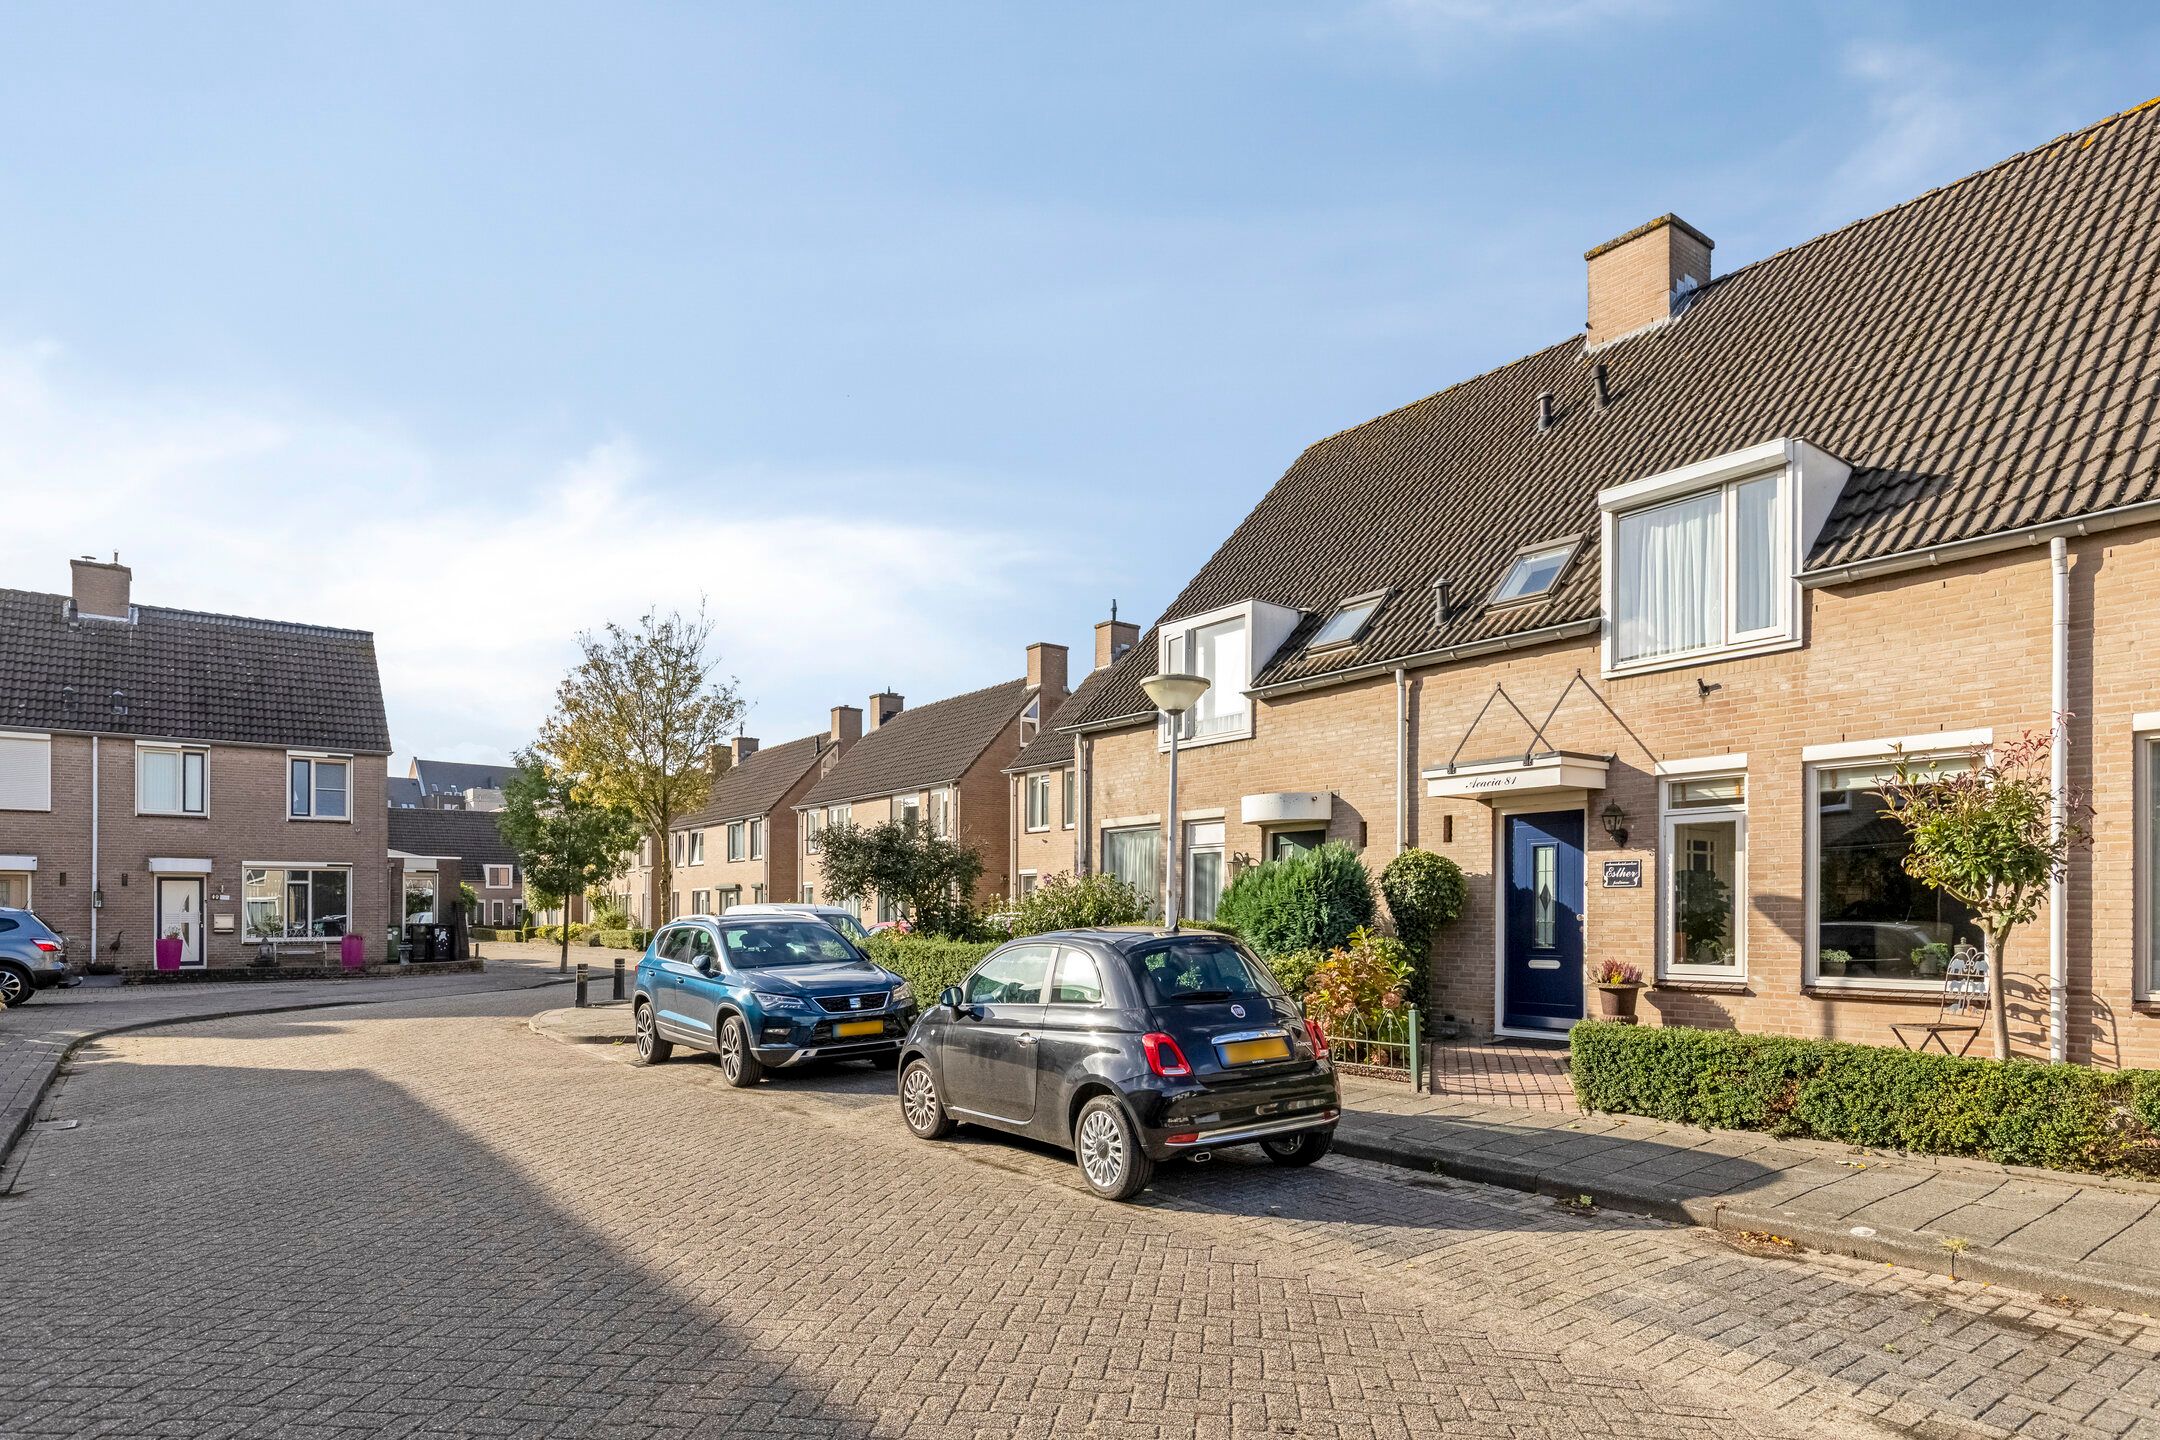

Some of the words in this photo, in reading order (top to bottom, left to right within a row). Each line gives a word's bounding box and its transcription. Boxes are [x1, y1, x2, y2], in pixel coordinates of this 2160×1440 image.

[1465, 777, 1501, 788] Acacia
[1504, 776, 1517, 785] 81
[1605, 867, 1638, 878] Esther
